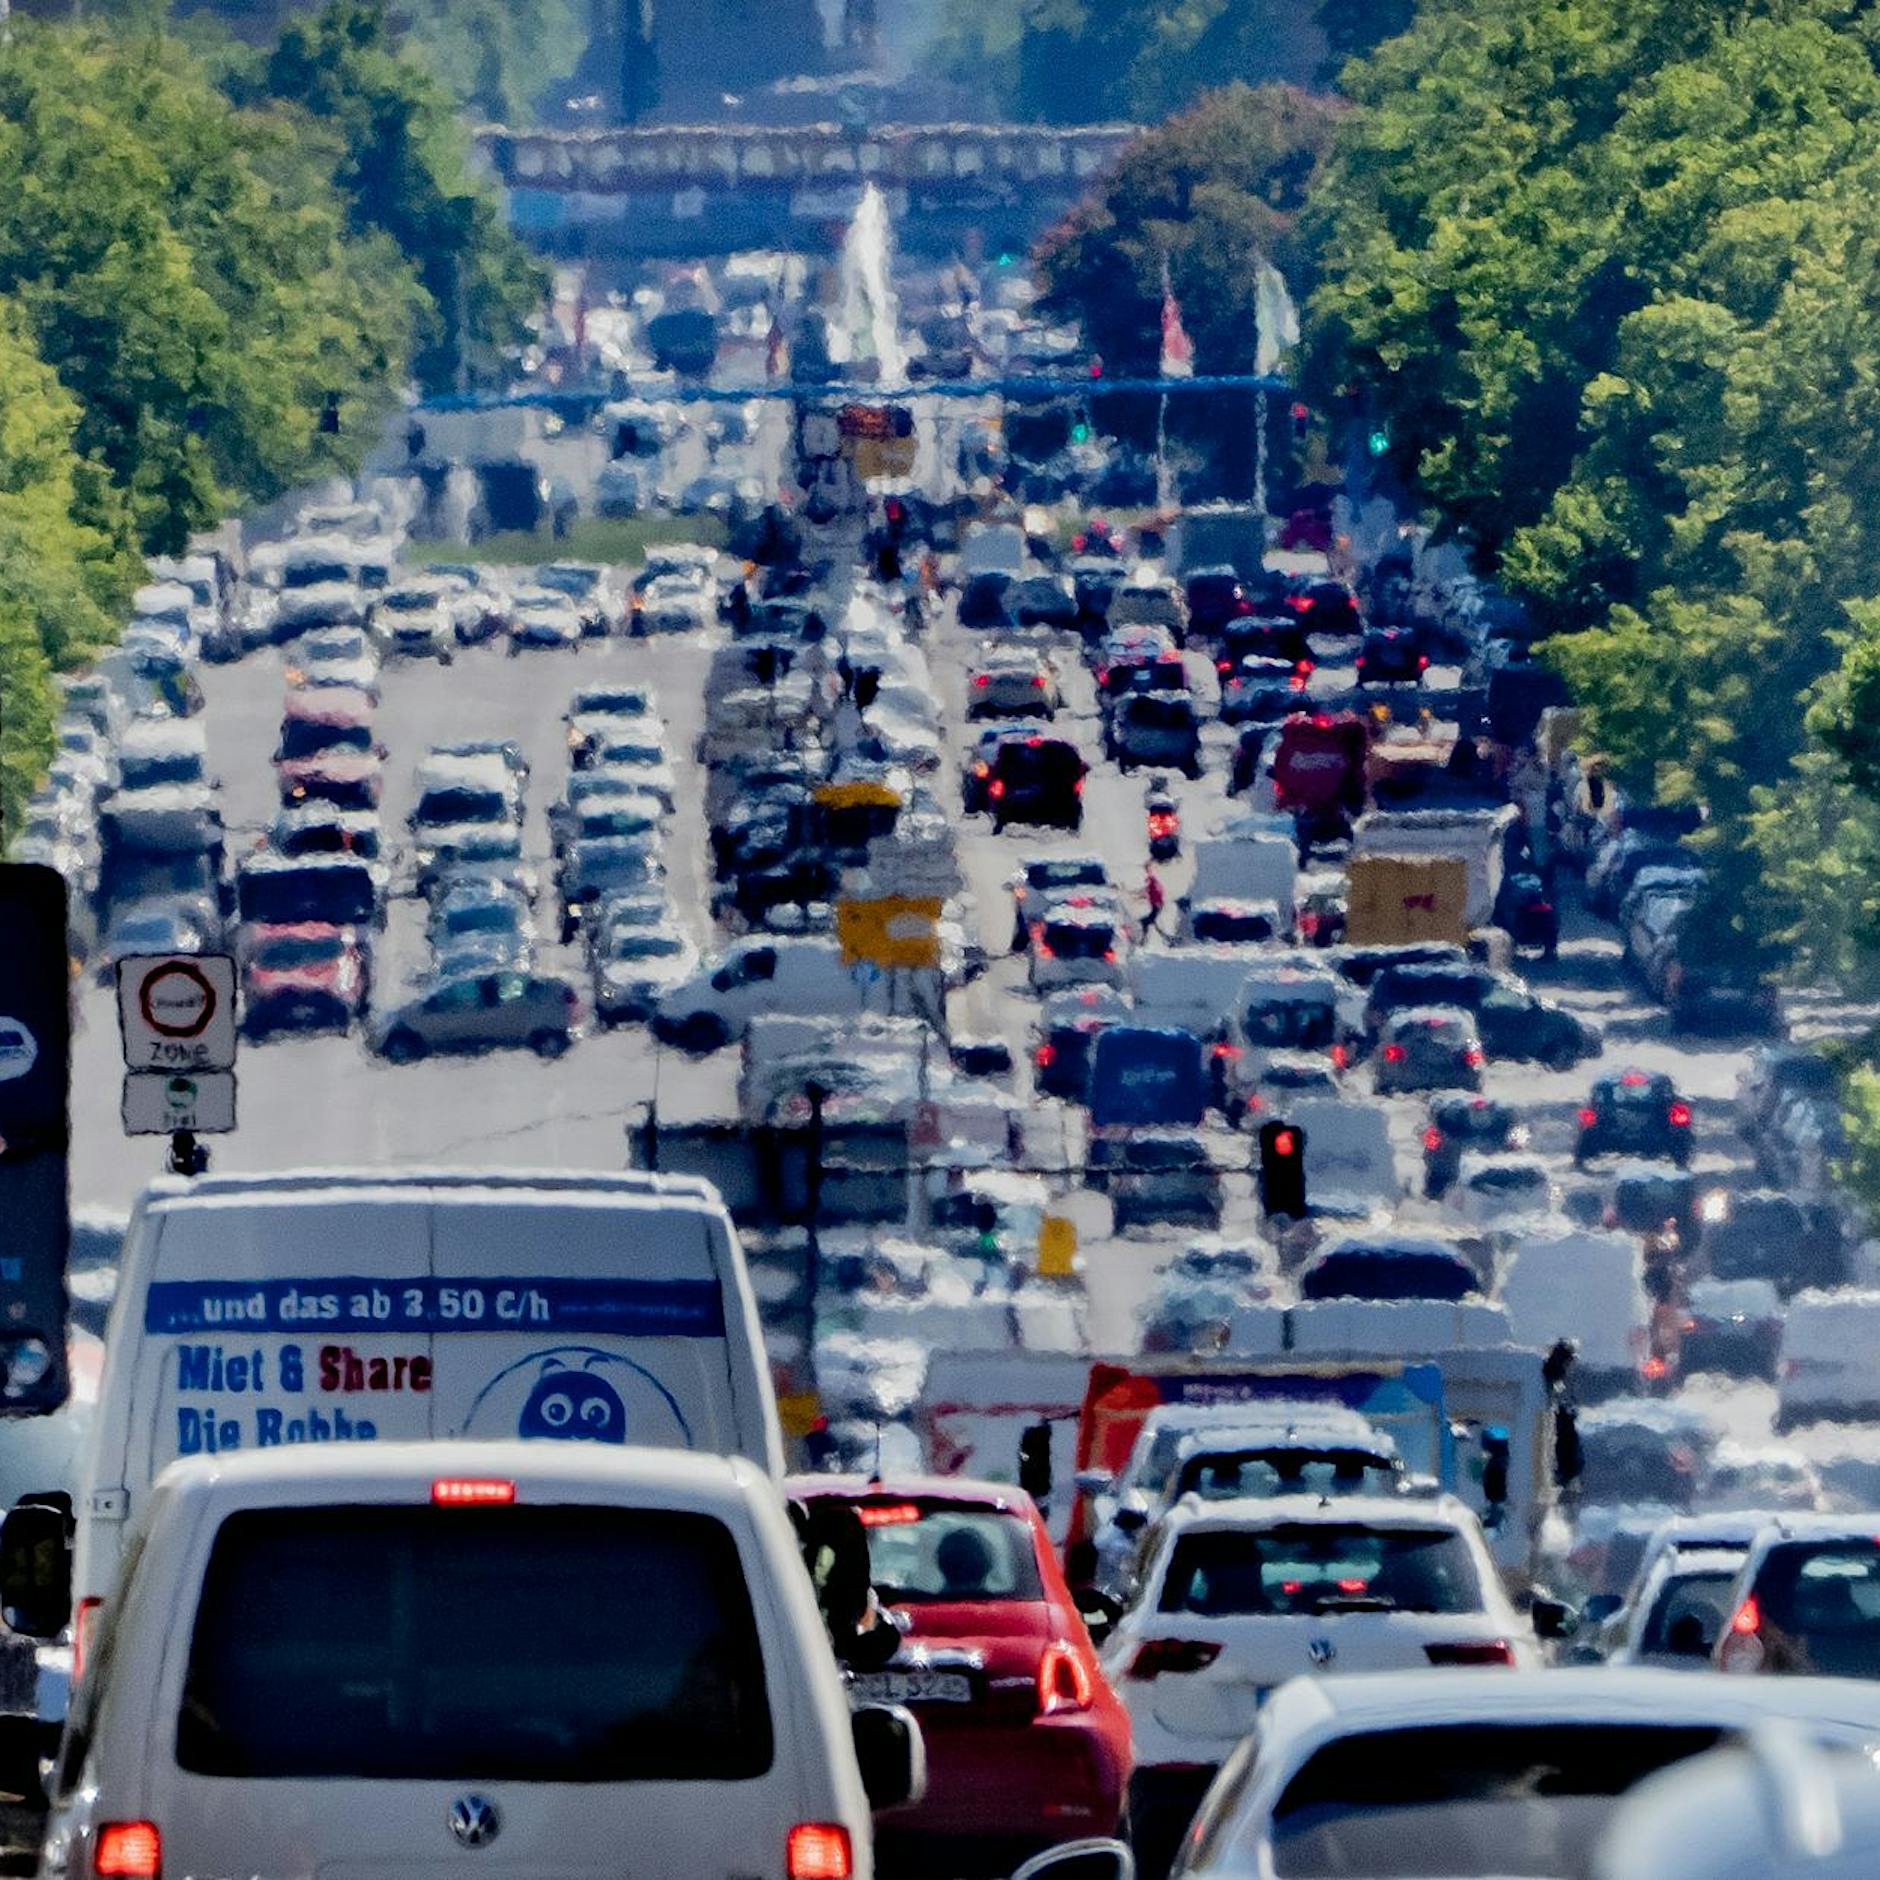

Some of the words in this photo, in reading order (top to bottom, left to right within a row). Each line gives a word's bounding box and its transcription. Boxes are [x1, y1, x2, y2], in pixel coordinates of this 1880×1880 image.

[279, 1288, 340, 1320] das
[350, 1287, 391, 1320] ab
[177, 1345, 264, 1393] Miet
[279, 1344, 304, 1393] &
[319, 1345, 433, 1393] Share
[177, 1407, 241, 1456] Die
